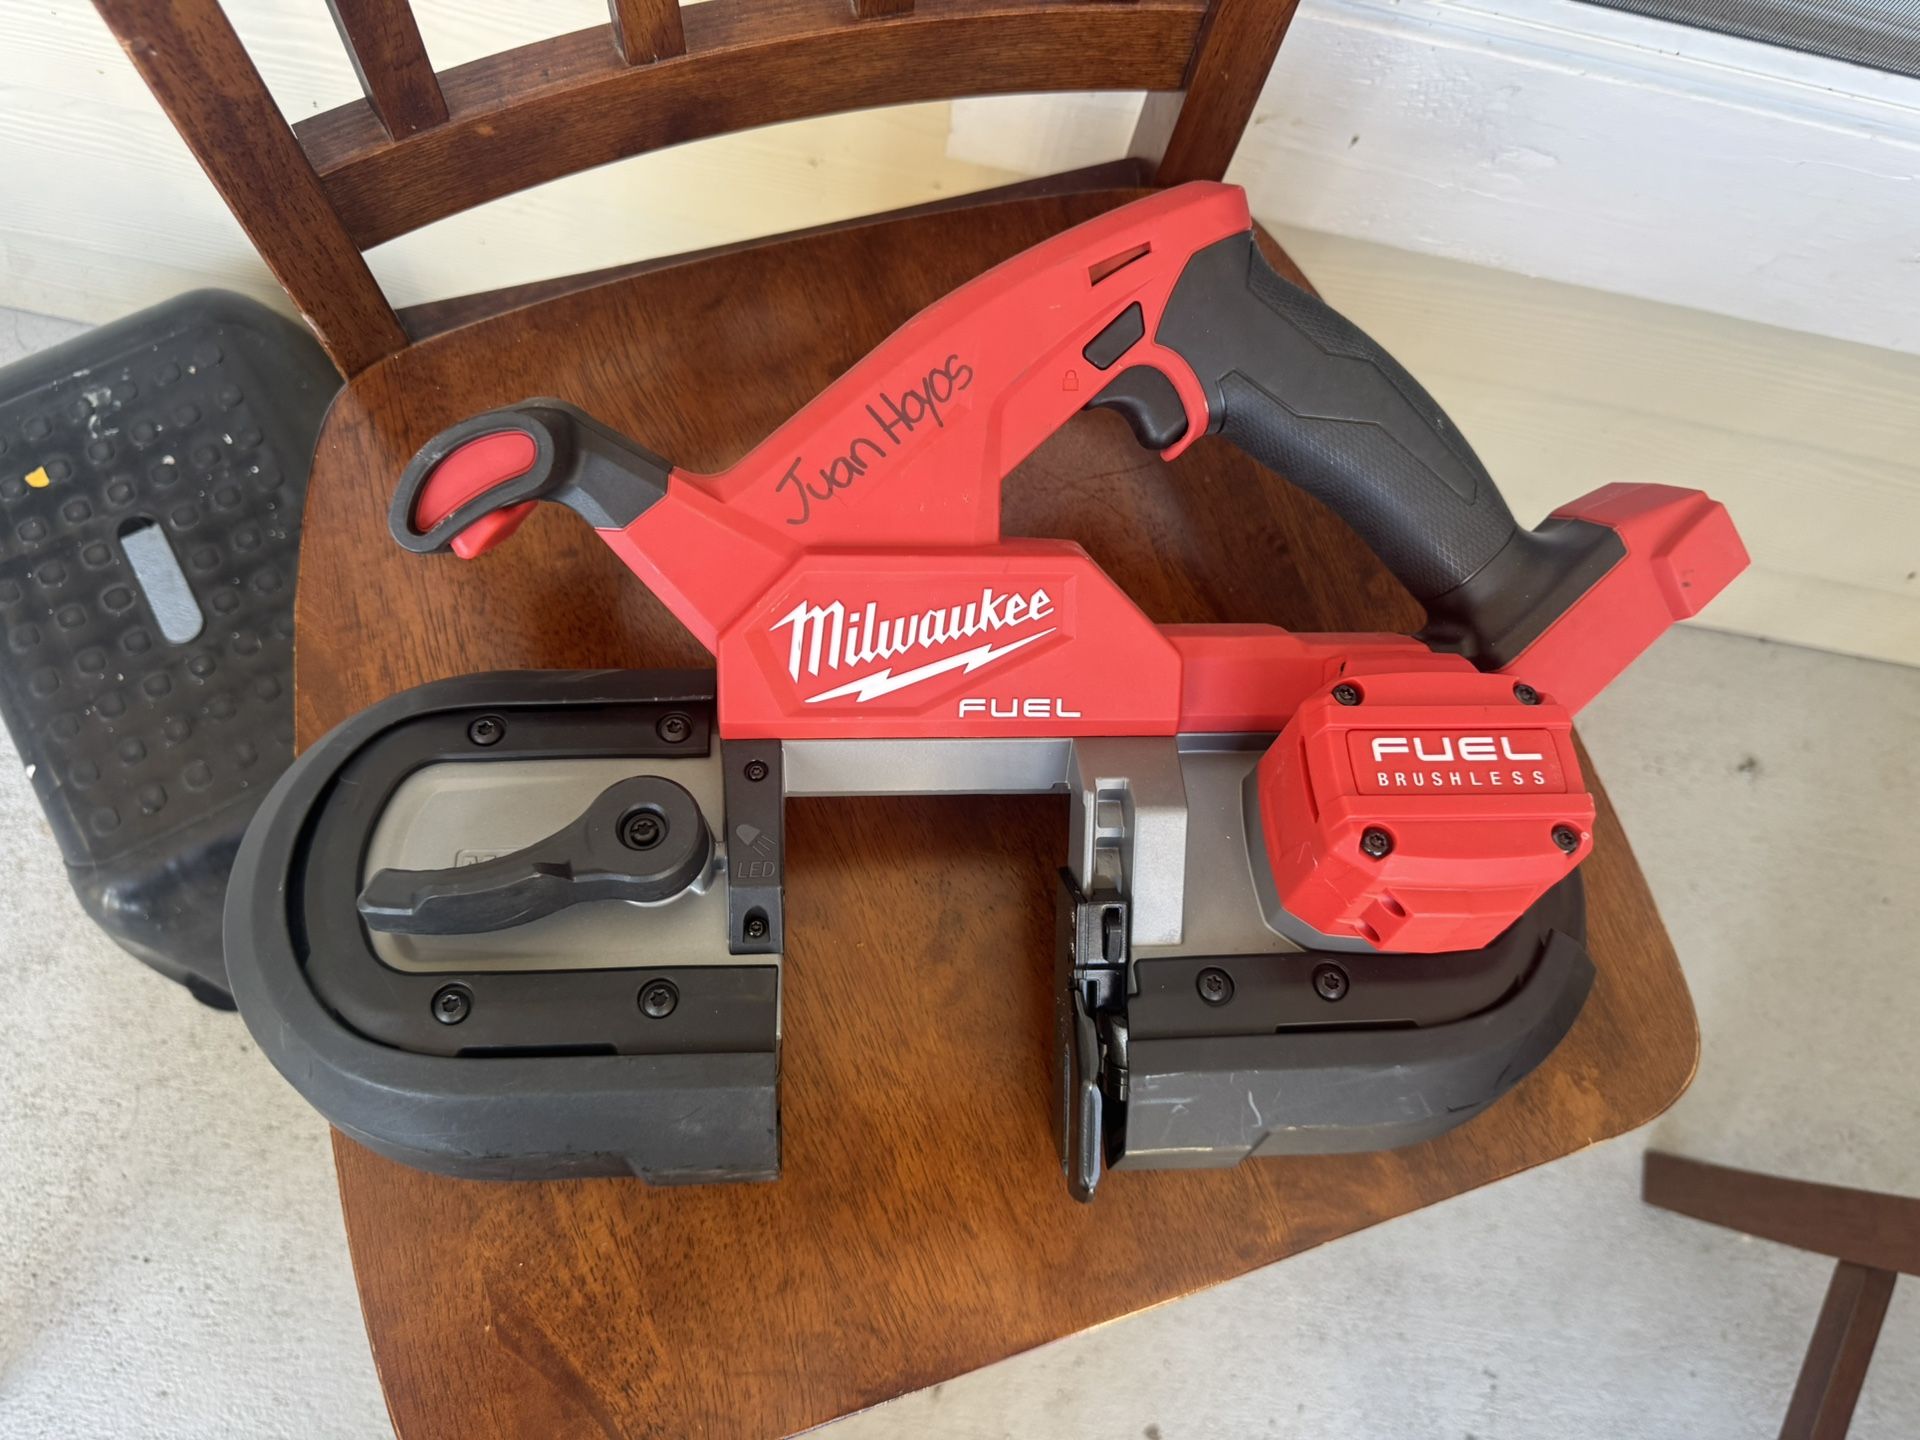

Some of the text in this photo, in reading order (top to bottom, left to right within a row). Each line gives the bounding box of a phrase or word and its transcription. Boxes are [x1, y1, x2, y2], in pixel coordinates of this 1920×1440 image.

[775, 437, 887, 526] Juan
[768, 587, 1055, 685] Milwaukee
[957, 697, 1082, 718] FUEL
[1371, 736, 1543, 762] FUEL
[1376, 770, 1546, 787] BRUSHLESS
[736, 860, 776, 879] LED
